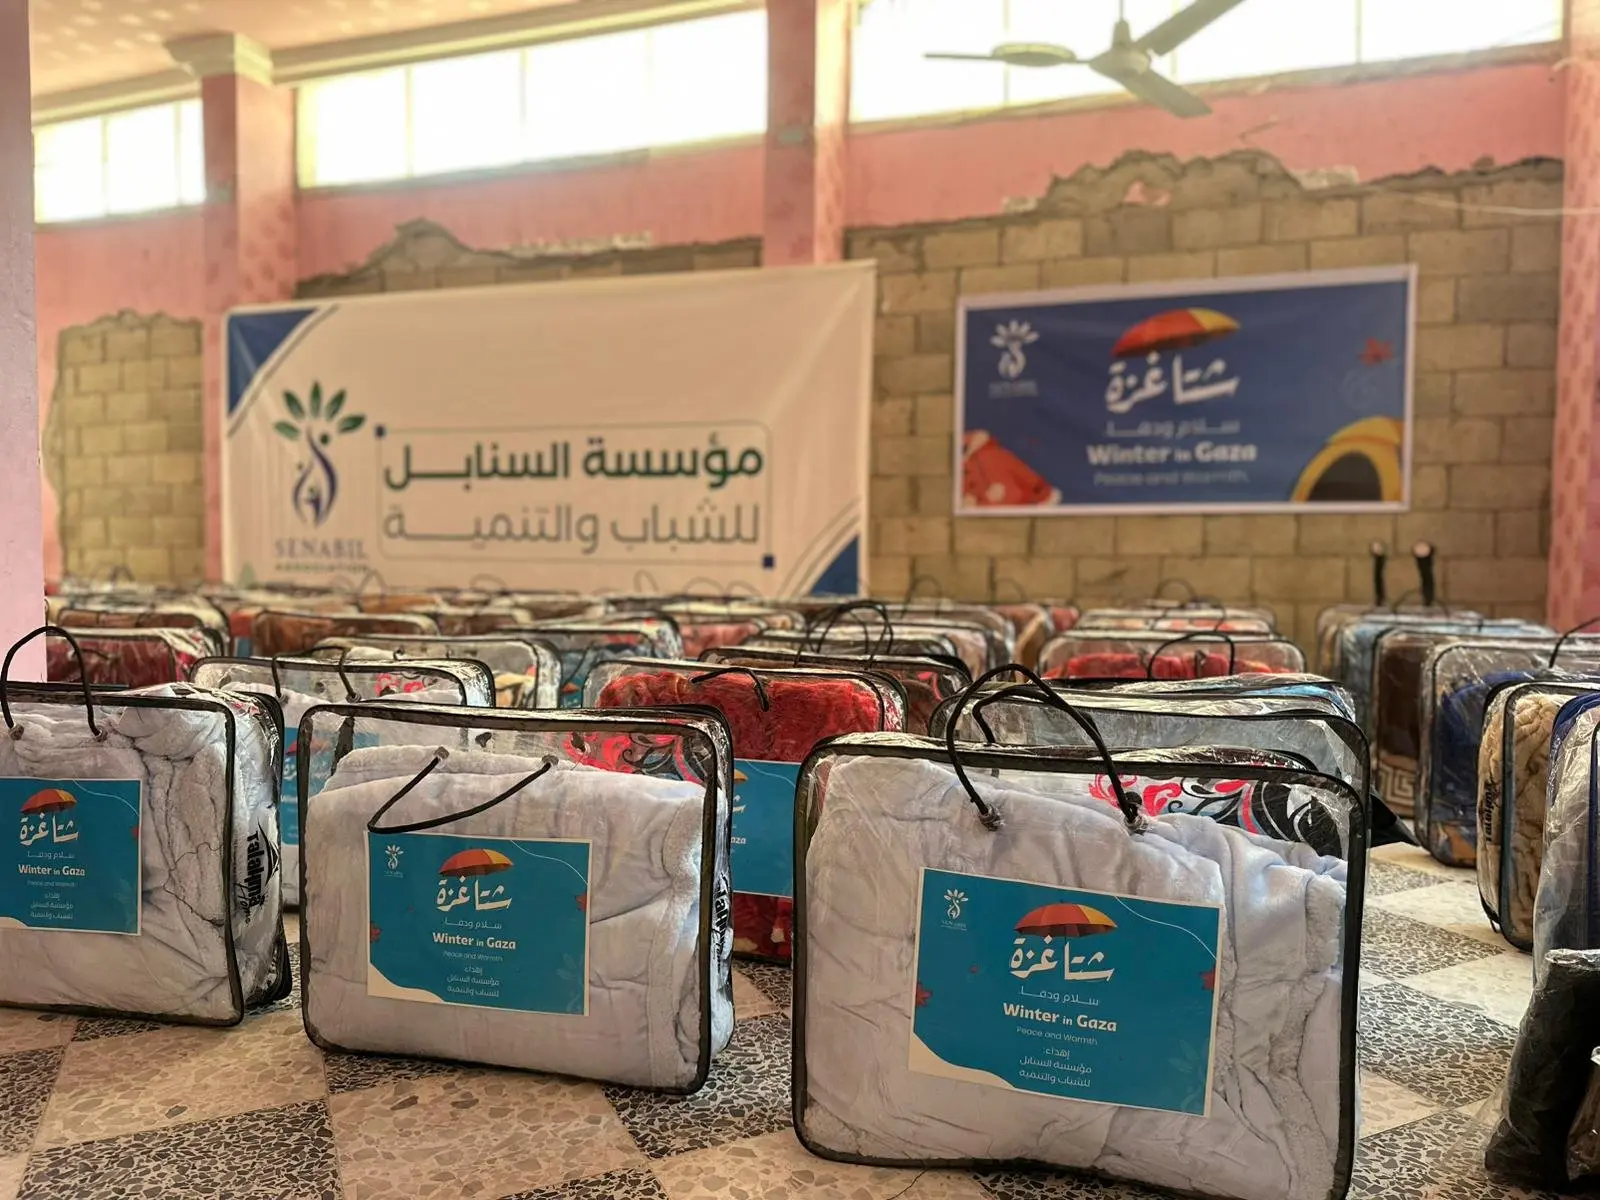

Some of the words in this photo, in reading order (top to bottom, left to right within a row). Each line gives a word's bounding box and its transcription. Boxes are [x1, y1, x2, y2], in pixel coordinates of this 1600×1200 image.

[1105, 351, 1168, 413] غزة
[1171, 353, 1240, 405] شتا
[384, 440, 570, 492] السنابل
[583, 432, 763, 489] مؤسسة
[1086, 444, 1171, 465] Winter
[1174, 449, 1192, 462] in
[1195, 441, 1257, 462] Gaza
[383, 503, 598, 554] والتنمية
[610, 498, 760, 552] للشباب
[274, 537, 369, 559] SENABIL
[20, 812, 49, 846] غزة
[52, 815, 79, 843] شتا
[731, 837, 746, 845] aza
[18, 864, 52, 875] Winter
[53, 868, 61, 876] in
[62, 865, 85, 876] Gaza
[436, 875, 471, 912] غزة
[474, 879, 512, 911] شتا
[432, 932, 474, 946] Winter
[486, 937, 516, 950] Gaza
[1010, 934, 1058, 979] غزة
[1064, 941, 1115, 982] شتا
[1063, 994, 1099, 1006] سلام
[1003, 1002, 1060, 1023] Winter
[1062, 1015, 1073, 1026] in
[1076, 1014, 1117, 1032] Gaza
[1016, 1026, 1043, 1037] Peace
[1044, 1031, 1062, 1040] and
[1063, 1033, 1098, 1045] Warmth
[1053, 1061, 1092, 1075] مؤسسة
